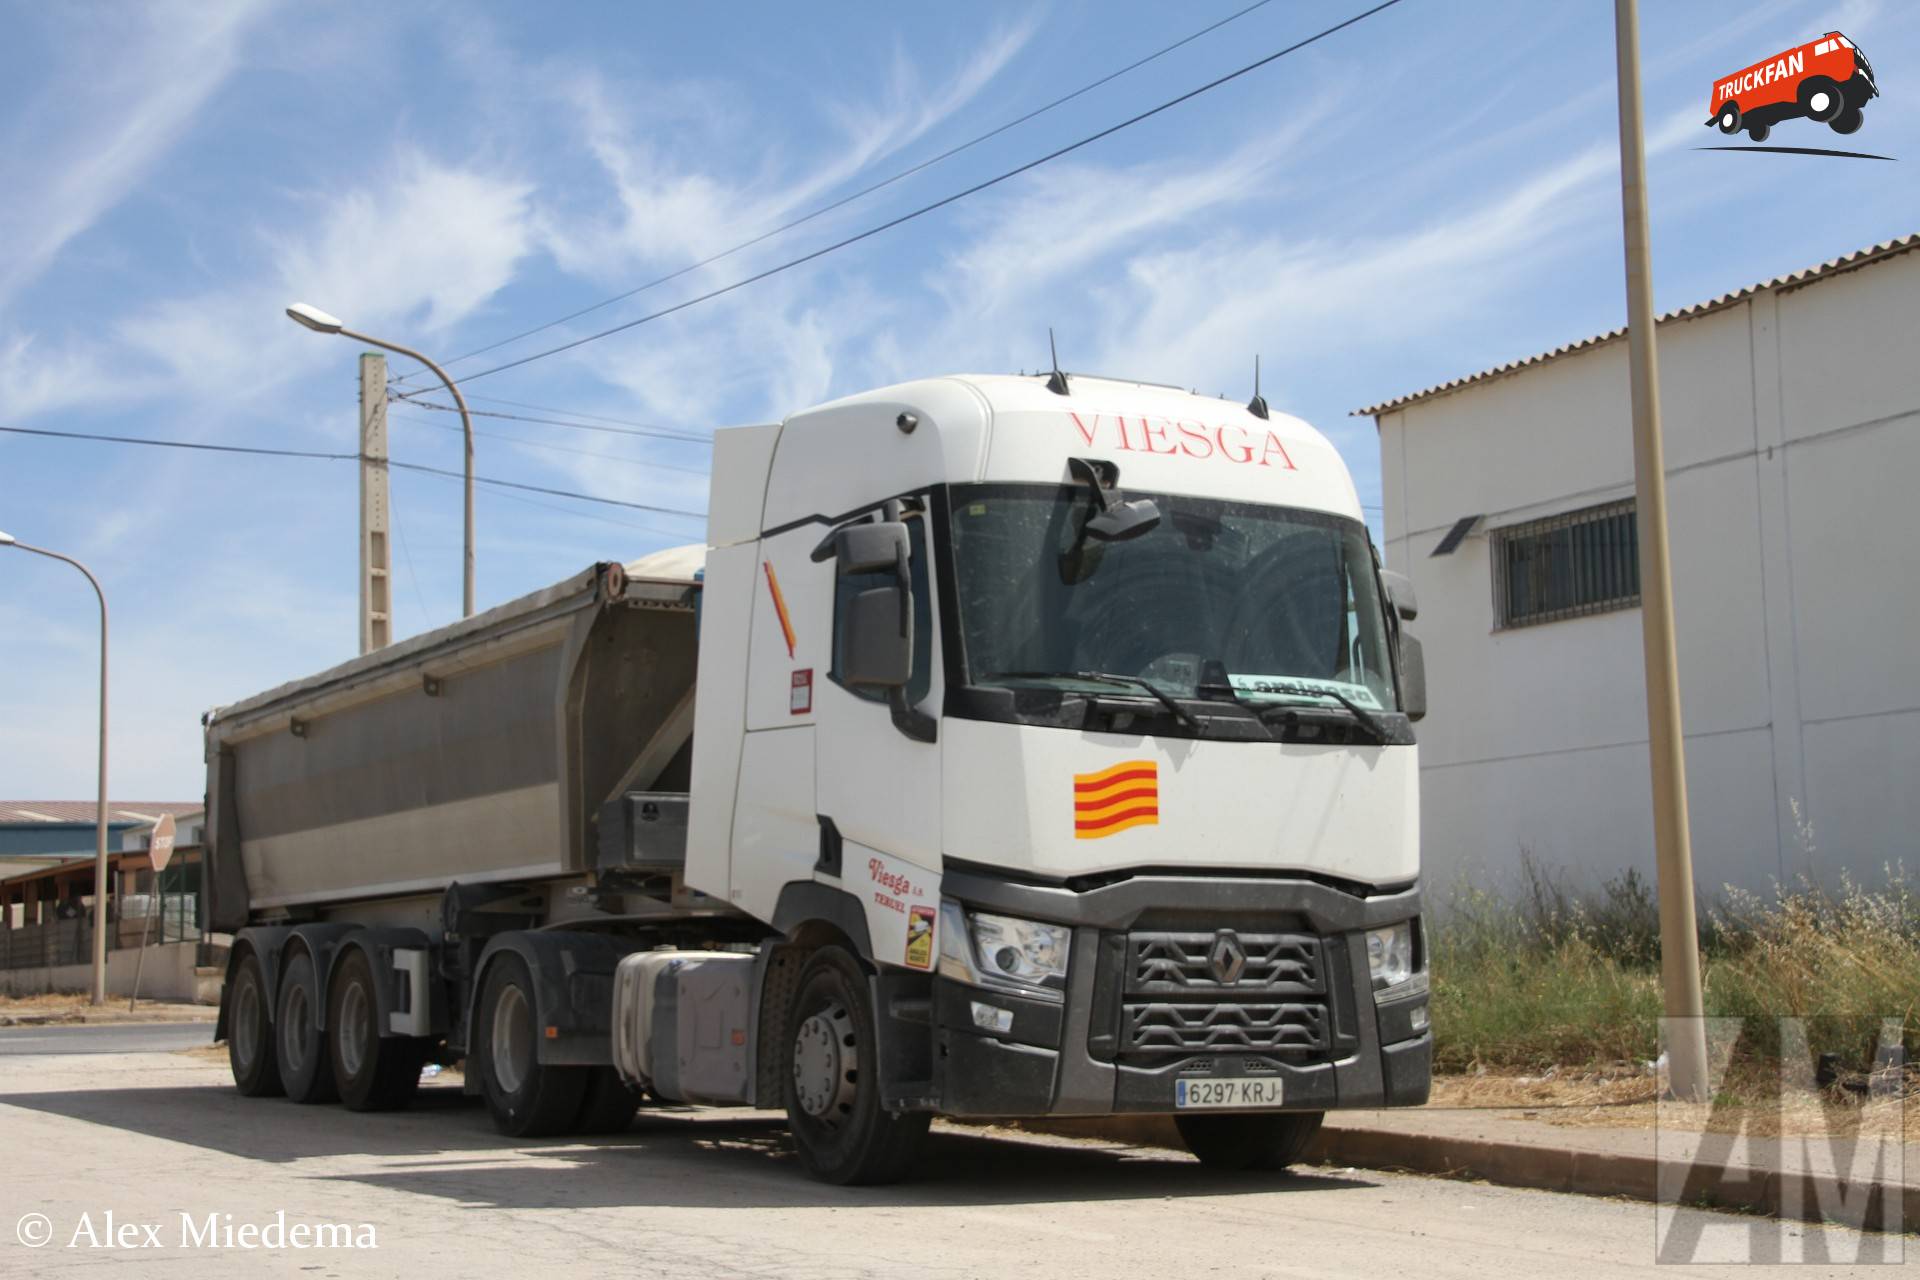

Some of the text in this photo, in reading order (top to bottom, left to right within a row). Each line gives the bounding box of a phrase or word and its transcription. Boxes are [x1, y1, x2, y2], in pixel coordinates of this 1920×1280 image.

[1067, 410, 1298, 471] VIESGA
[156, 835, 174, 850] STOP
[868, 858, 910, 896] Viesga
[1189, 1081, 1276, 1104] 6297 KRJ
